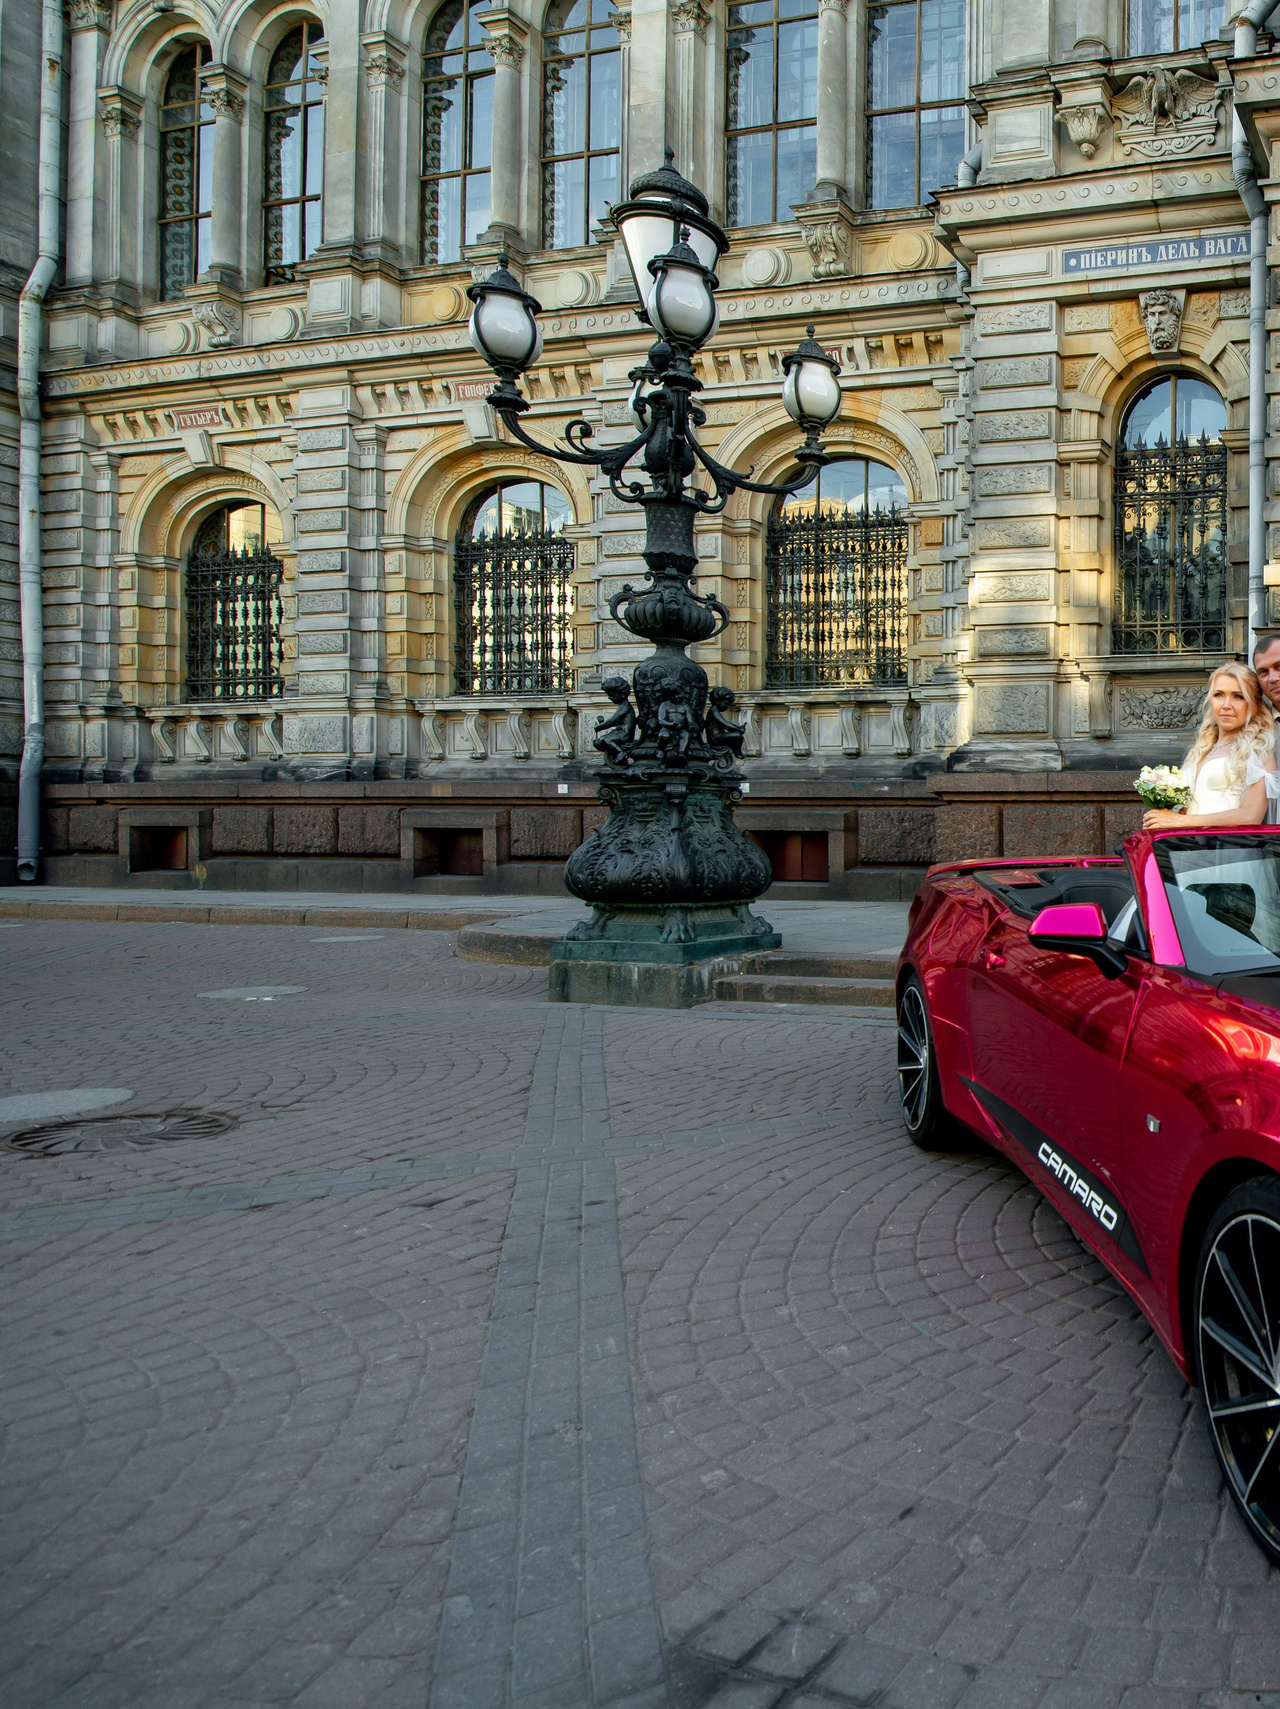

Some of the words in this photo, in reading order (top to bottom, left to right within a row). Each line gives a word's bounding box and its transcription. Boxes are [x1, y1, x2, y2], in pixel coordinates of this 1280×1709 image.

[1157, 241, 1199, 262] ДЕЛЬ
[1205, 237, 1248, 255] ВАГА
[459, 383, 500, 397] ГОПФЕР
[1038, 1142, 1117, 1230] CAMARO
